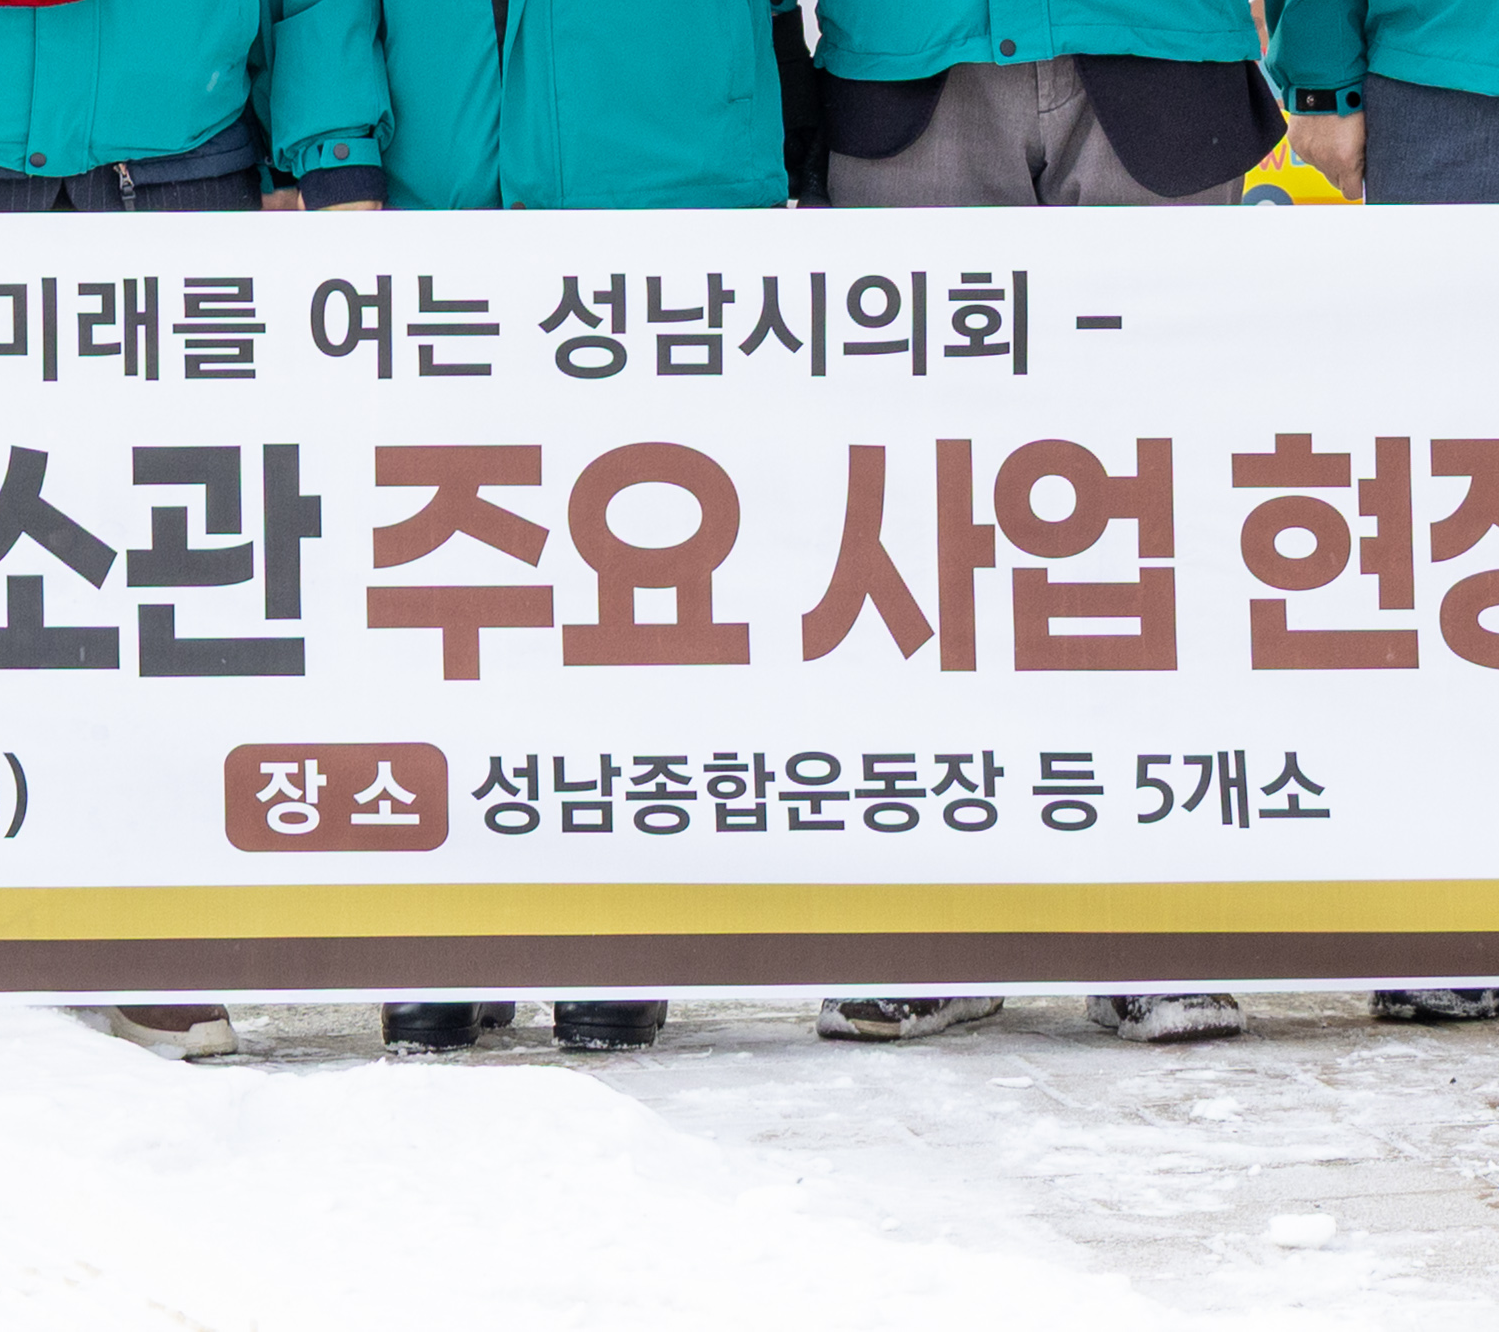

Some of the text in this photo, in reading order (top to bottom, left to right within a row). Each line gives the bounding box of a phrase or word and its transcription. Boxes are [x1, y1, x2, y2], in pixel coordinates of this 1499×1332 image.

[309, 274, 501, 381] 여는
[538, 269, 1029, 380] 성남시의회
[365, 441, 752, 682] 주요
[800, 436, 1179, 673] 사업
[471, 749, 1005, 836] 성남종합운동장
[1031, 751, 1105, 833] 등
[1135, 748, 1332, 830] 5개소
